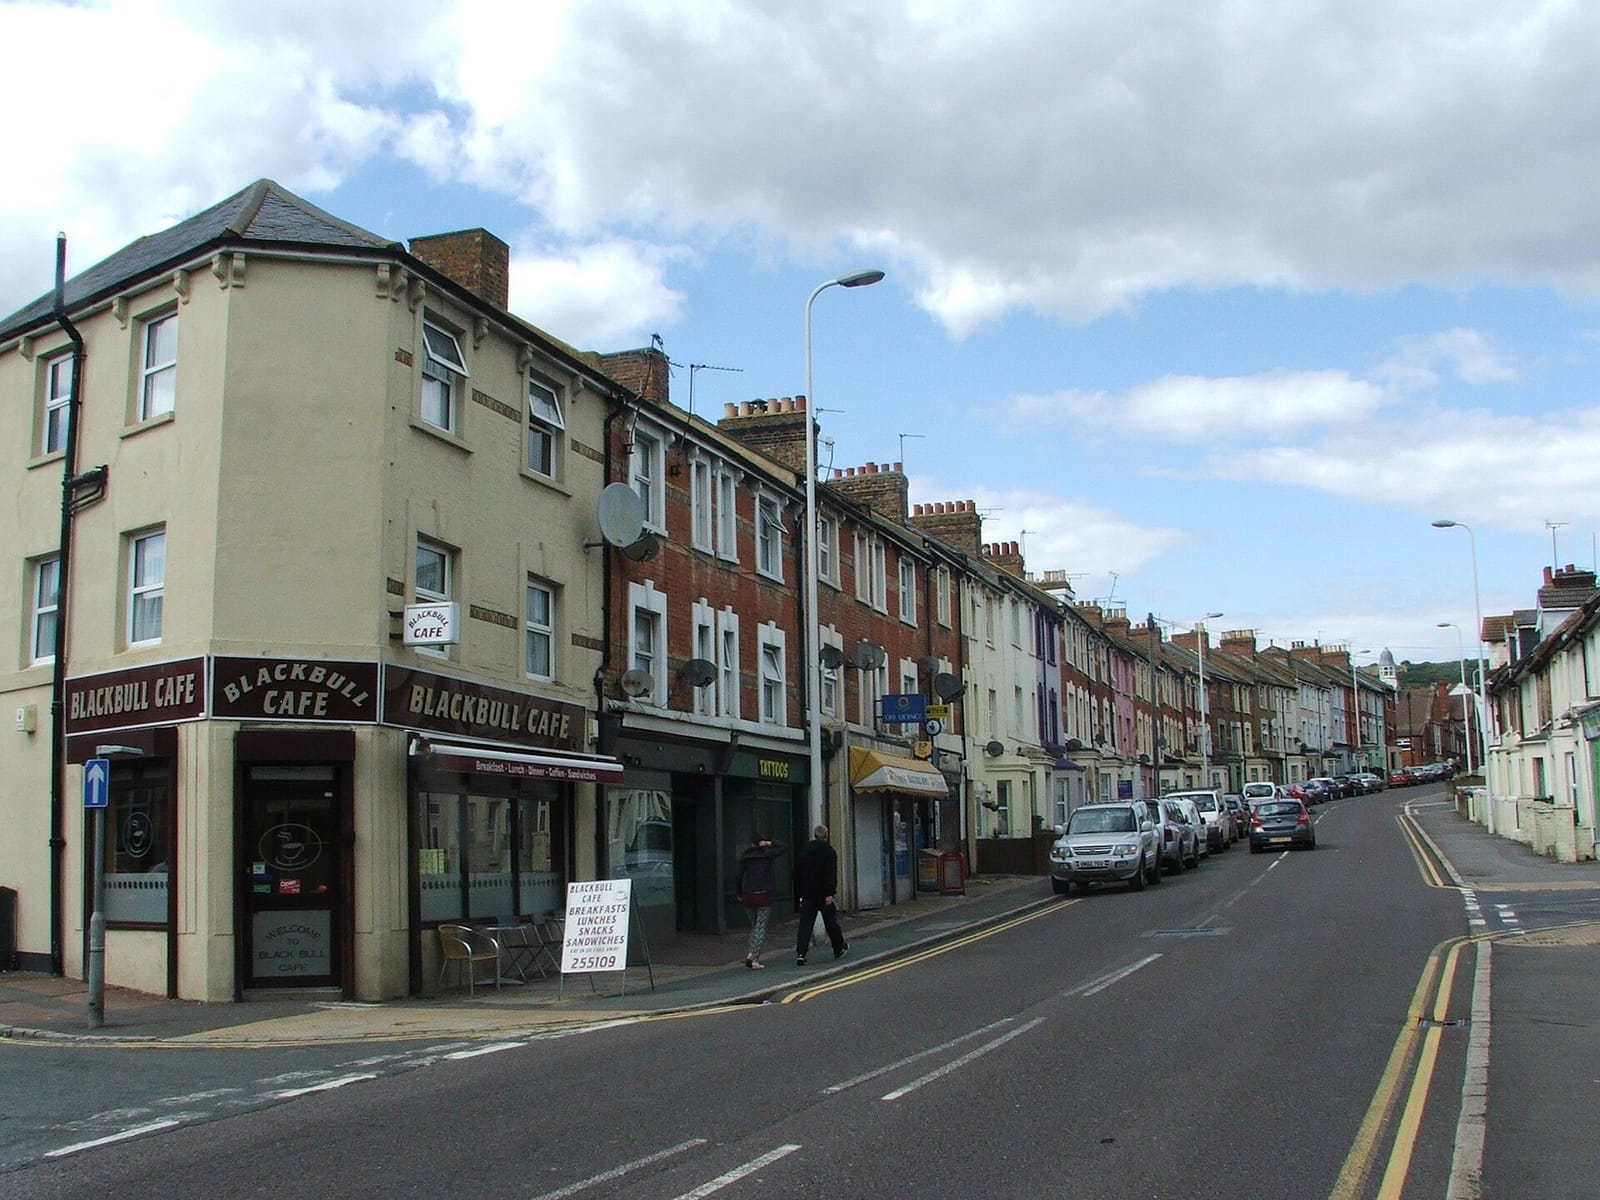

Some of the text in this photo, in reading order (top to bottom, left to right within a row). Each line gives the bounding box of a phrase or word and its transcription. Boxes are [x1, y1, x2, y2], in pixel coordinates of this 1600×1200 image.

[408, 610, 449, 628] BLACKBULL
[413, 627, 443, 638] CAFE
[223, 663, 369, 707] BLACKBULL
[70, 673, 195, 719] BLACKBULL CAFE
[263, 690, 329, 716] CAFE
[409, 684, 570, 739] BLACKBULL CAFE
[476, 760, 505, 773] Breakfast
[508, 763, 525, 774] Lunch
[528, 765, 545, 776] Dinner
[567, 769, 597, 780] Sandwiches
[759, 759, 789, 778] TATTOOS
[570, 883, 613, 894] BLACKBULL
[582, 895, 601, 903] CAFE
[569, 904, 627, 916] BREAKFASTS
[577, 915, 617, 926] LUNCHES
[578, 926, 614, 936] SNACKS
[566, 936, 625, 948] SANDWICHES
[571, 955, 616, 969] 255109
